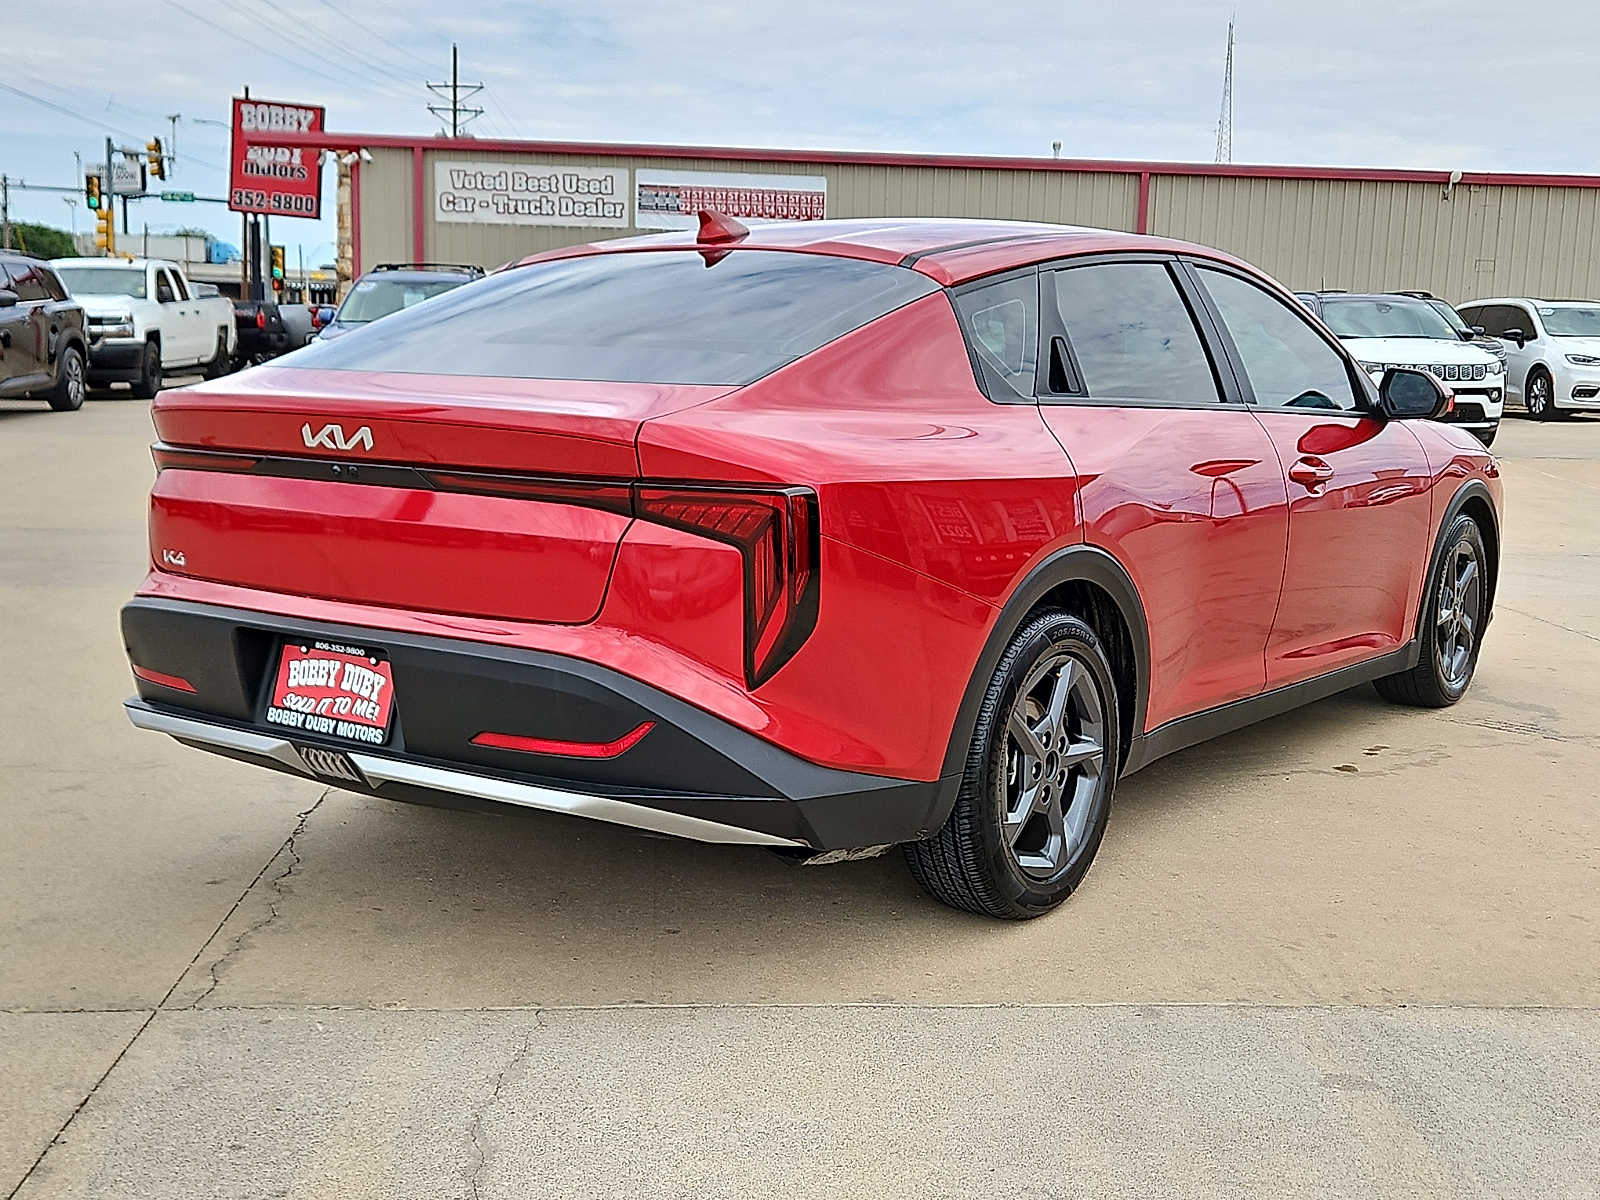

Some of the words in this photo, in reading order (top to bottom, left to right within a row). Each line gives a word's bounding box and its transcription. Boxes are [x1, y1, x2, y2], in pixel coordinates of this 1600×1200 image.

[241, 102, 315, 133] BOBBY
[450, 170, 508, 191] Voted
[512, 172, 559, 193] Best
[563, 174, 614, 195] Used
[233, 189, 315, 213] 352-9800
[440, 192, 475, 212] Car
[492, 194, 554, 216] Truck
[558, 197, 625, 218] Dealer
[302, 422, 374, 451] KIA
[163, 549, 186, 566] K4
[1052, 627, 1095, 644] 205/55R16
[315, 642, 365, 656] 806-352-9800
[288, 659, 340, 688] BOBBY
[340, 662, 387, 702] DUBY
[282, 692, 316, 713] SOLD
[315, 698, 334, 715] IT
[332, 697, 352, 715] TO
[351, 698, 380, 722] ME!
[267, 707, 305, 728] BOBBY
[305, 714, 337, 735] DUBY
[336, 721, 384, 744] MOTORS
